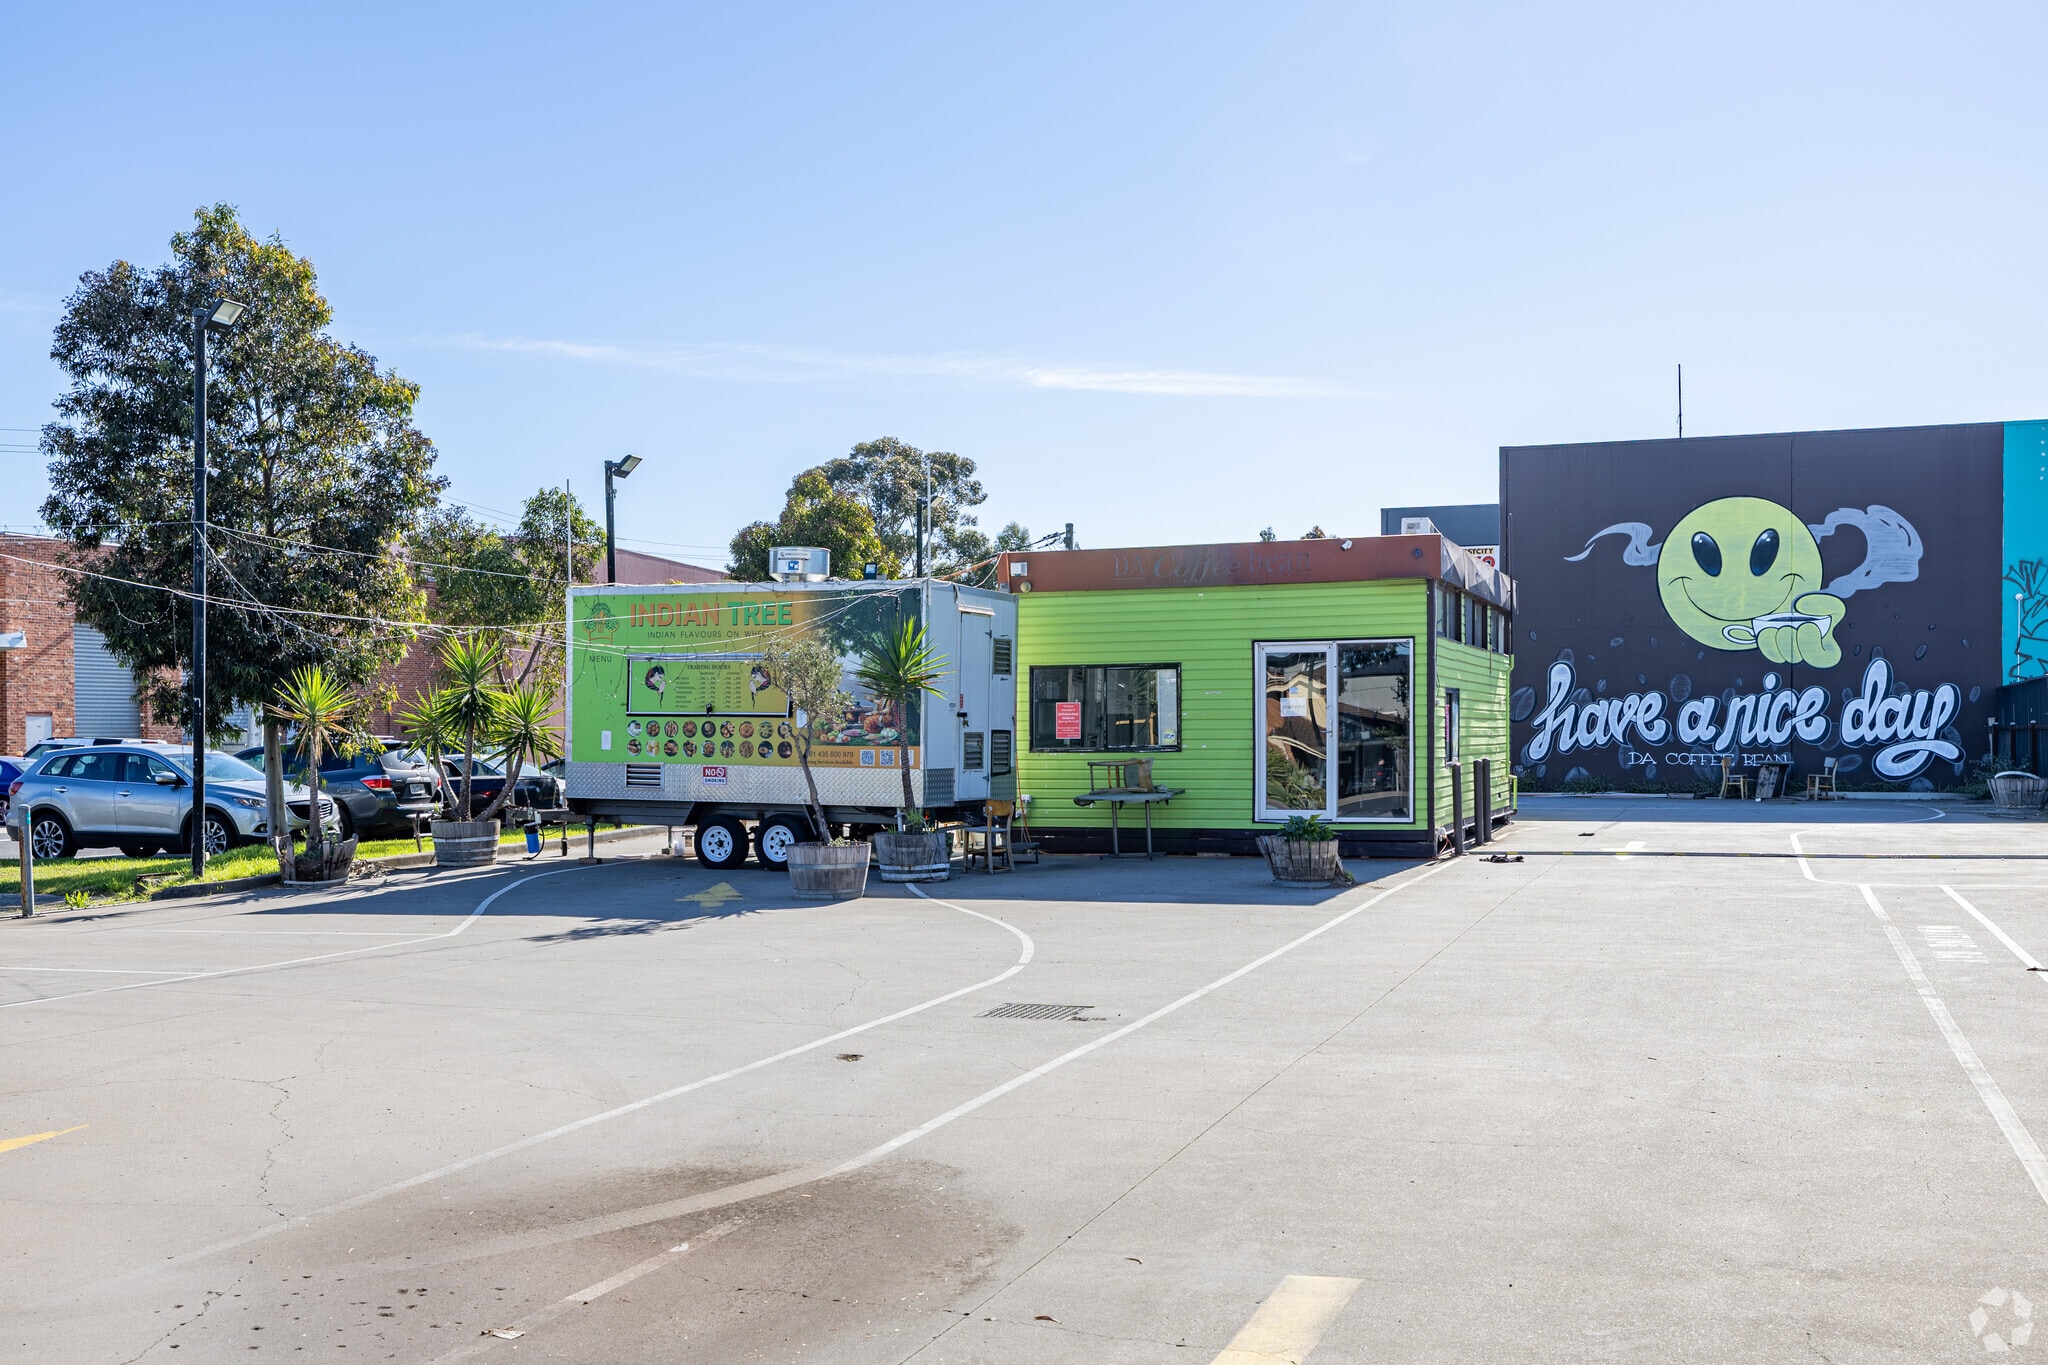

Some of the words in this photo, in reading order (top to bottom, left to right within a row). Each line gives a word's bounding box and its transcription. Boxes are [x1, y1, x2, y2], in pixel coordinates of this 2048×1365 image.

[1153, 552, 1242, 583] Coffee
[1248, 546, 1311, 573] bean
[629, 601, 720, 628] INDIAN
[726, 600, 793, 627] TREE
[647, 631, 676, 639] INDIAN
[680, 630, 722, 638] FLAVOURS
[726, 630, 740, 638] ON
[589, 655, 612, 663] MENU
[1528, 661, 1670, 761] have
[1677, 695, 1721, 746] a
[1716, 673, 1830, 751] nice
[1841, 659, 1965, 780] day
[1627, 752, 1657, 765] DA
[1665, 752, 1735, 766] COFFEE
[1741, 753, 1787, 767] BEAN
[705, 768, 716, 776] NO
